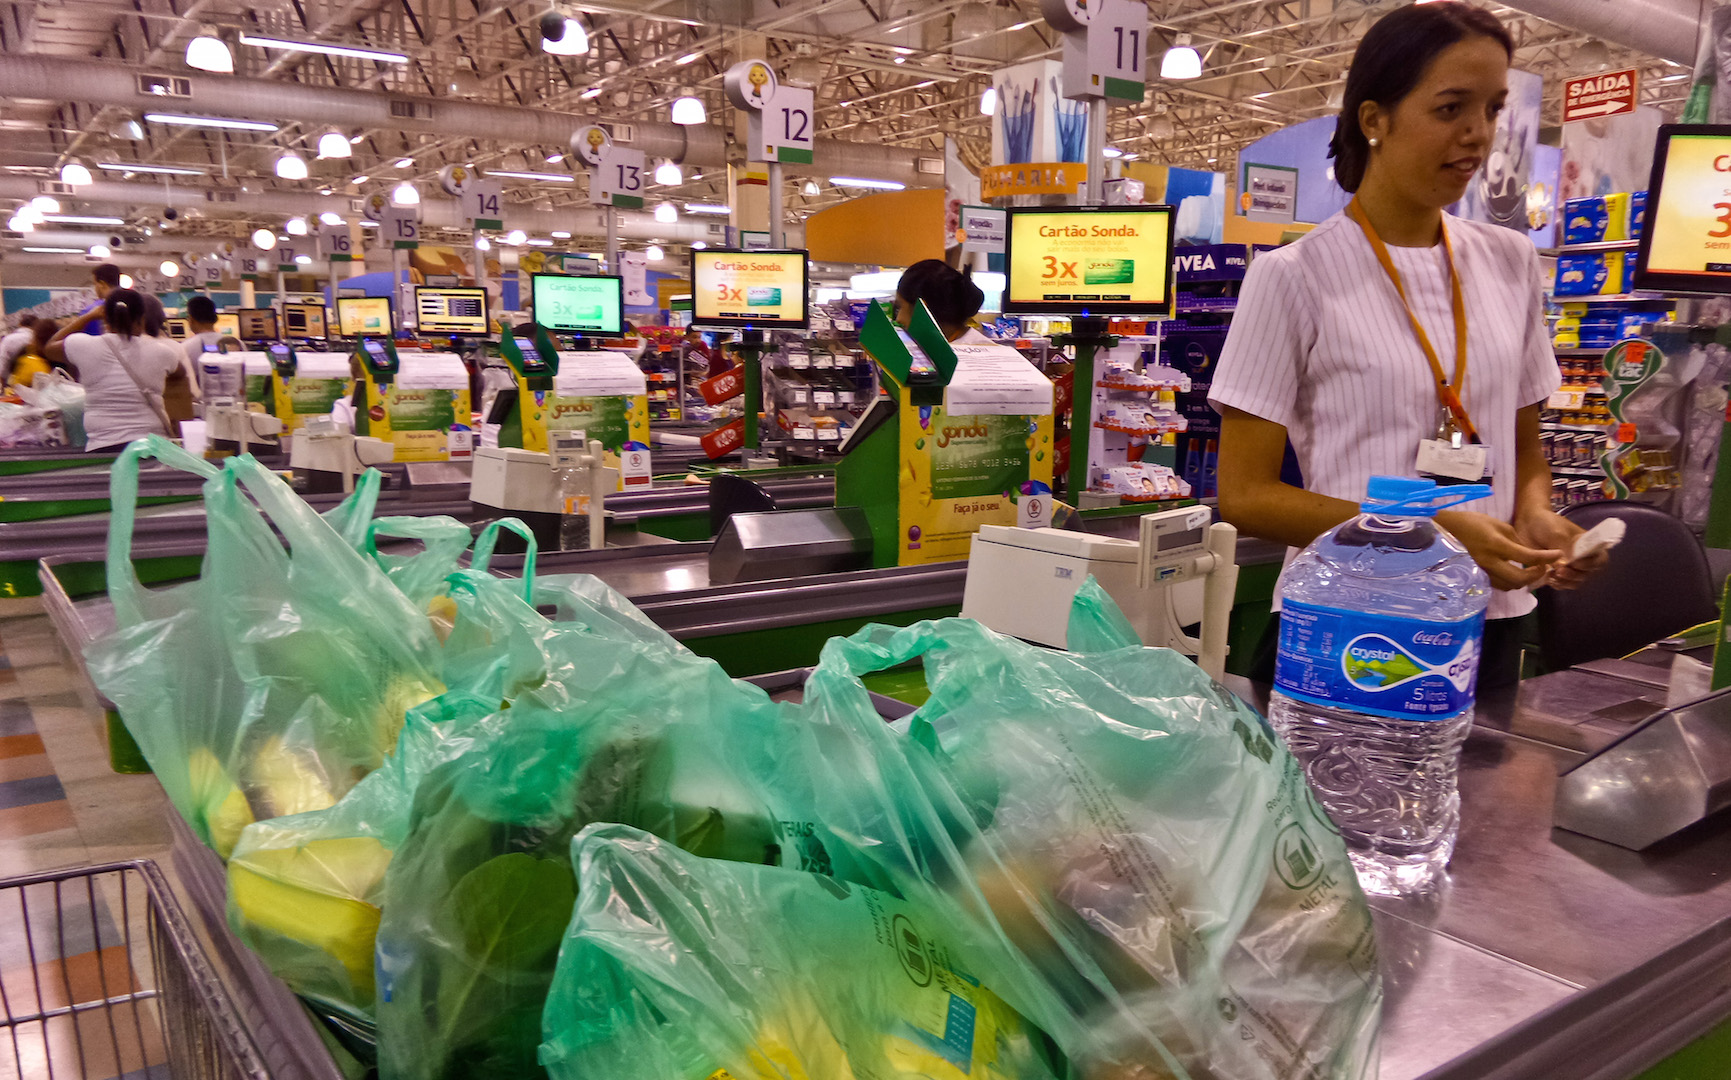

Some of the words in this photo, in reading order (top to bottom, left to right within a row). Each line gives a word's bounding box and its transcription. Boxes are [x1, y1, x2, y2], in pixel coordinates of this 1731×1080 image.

[1114, 26, 1139, 72] 11
[1569, 74, 1631, 97] SAÍDA
[781, 108, 808, 142] 12
[616, 164, 641, 191] 13
[477, 194, 499, 215] 14
[396, 218, 416, 238] 15
[1039, 224, 1089, 238] Cartão
[1091, 225, 1139, 238] Sonda.
[331, 234, 350, 251] 16
[279, 248, 294, 262] 17
[1174, 253, 1216, 272] IVEA
[1225, 257, 1246, 266] NIVEA
[206, 267, 220, 280] 19
[242, 258, 257, 272] 18
[714, 261, 749, 271] Cartão
[750, 262, 784, 272] Sonda.
[1041, 256, 1078, 279] 3x
[717, 284, 743, 301] 3x
[552, 301, 573, 316] 3x
[937, 415, 988, 448] sonda
[954, 503, 970, 515] Faça
[972, 502, 979, 514] já
[1350, 647, 1396, 660] crystal
[1413, 688, 1424, 701] 5
[1299, 875, 1339, 912] METAL
